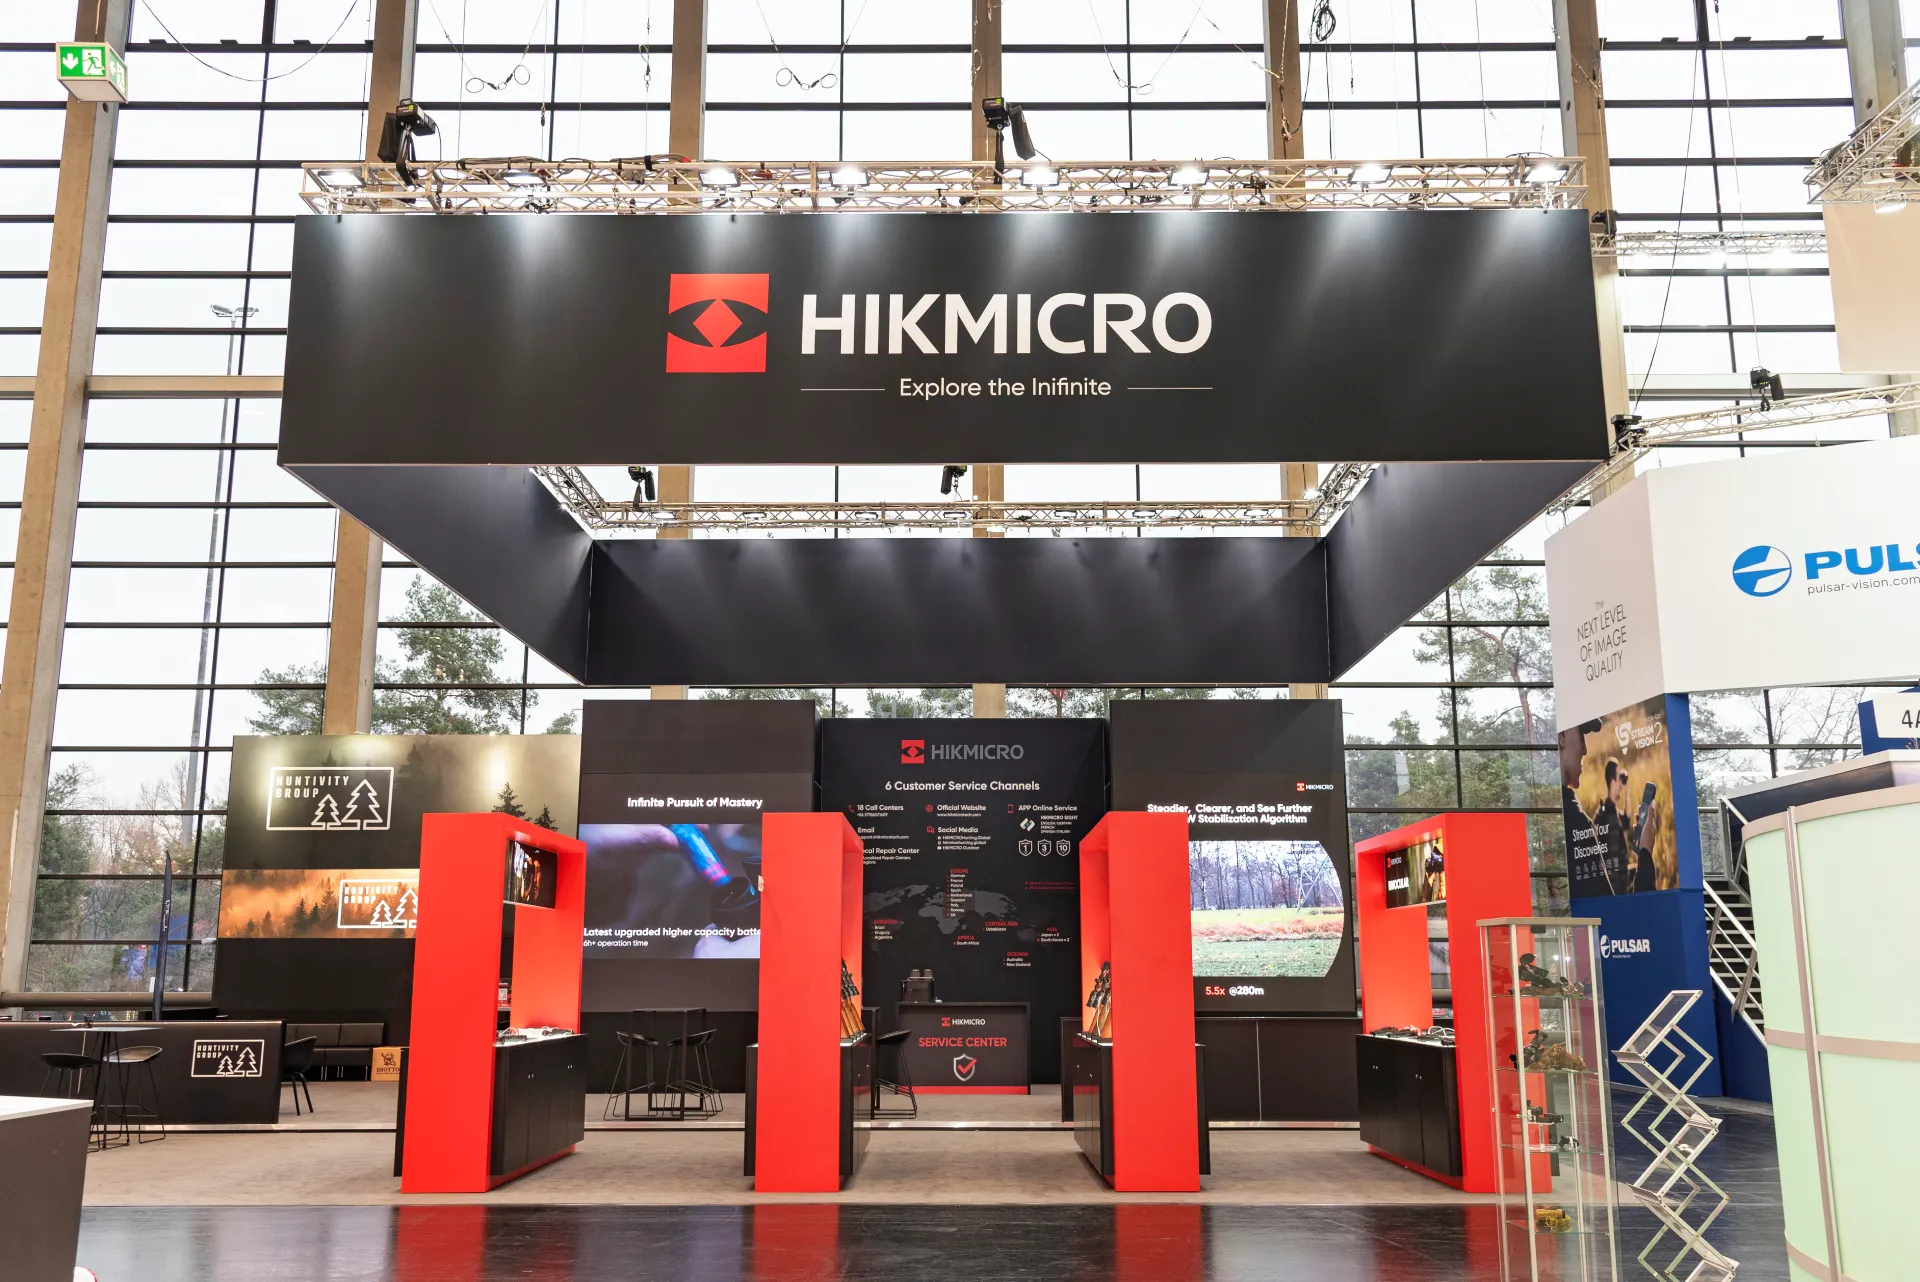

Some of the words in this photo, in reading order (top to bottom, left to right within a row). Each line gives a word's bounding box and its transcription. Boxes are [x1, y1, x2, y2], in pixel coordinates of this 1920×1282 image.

[801, 292, 1213, 354] HIKMICRO
[900, 378, 982, 400] Explore
[988, 378, 1025, 396] the
[1032, 377, 1112, 396] Inifinite
[1804, 543, 1920, 580] PUL
[1595, 600, 1605, 610] The
[1577, 617, 1598, 642] NEXT
[1599, 604, 1627, 630] LEVEL
[1580, 642, 1592, 662] OF
[1594, 625, 1627, 655] IMAGE
[1586, 649, 1624, 681] QUALITY
[1630, 724, 1654, 740] STREAM
[1634, 735, 1655, 749] VISION
[1654, 721, 1663, 743] 2
[931, 744, 1024, 760] HIKMICRO
[276, 776, 350, 786] HUNTIVITY
[885, 781, 892, 790] 6
[894, 781, 946, 790] Customer
[948, 781, 988, 790] Service
[989, 781, 1040, 790] Channels
[275, 788, 319, 798] GROUP
[627, 797, 665, 808] Infinite
[667, 797, 704, 808] Pursuit
[706, 797, 718, 808] of
[719, 797, 763, 810] Mastery
[1195, 803, 1235, 815] Clearer,
[1236, 803, 1256, 813] and
[1257, 803, 1276, 813] See
[1277, 803, 1313, 813] Further
[1198, 814, 1258, 824] Stabilization
[1260, 814, 1308, 825] Algorithm
[1572, 827, 1594, 842] Stream
[1574, 841, 1609, 859] Discoveries
[344, 886, 399, 895] HUNTIVITY
[343, 895, 377, 904] GROUP
[583, 928, 613, 937] Latest
[614, 928, 661, 939] upgraded
[662, 928, 693, 939] higher
[694, 928, 735, 939] capacity
[597, 940, 632, 948] operation
[1611, 939, 1651, 953] PULSAR
[1205, 986, 1226, 996] 5.5x
[1228, 985, 1265, 996] @280m
[952, 1018, 986, 1026] HIKMICRO
[918, 1037, 963, 1047] SERVICE
[965, 1037, 1007, 1047] CENTER
